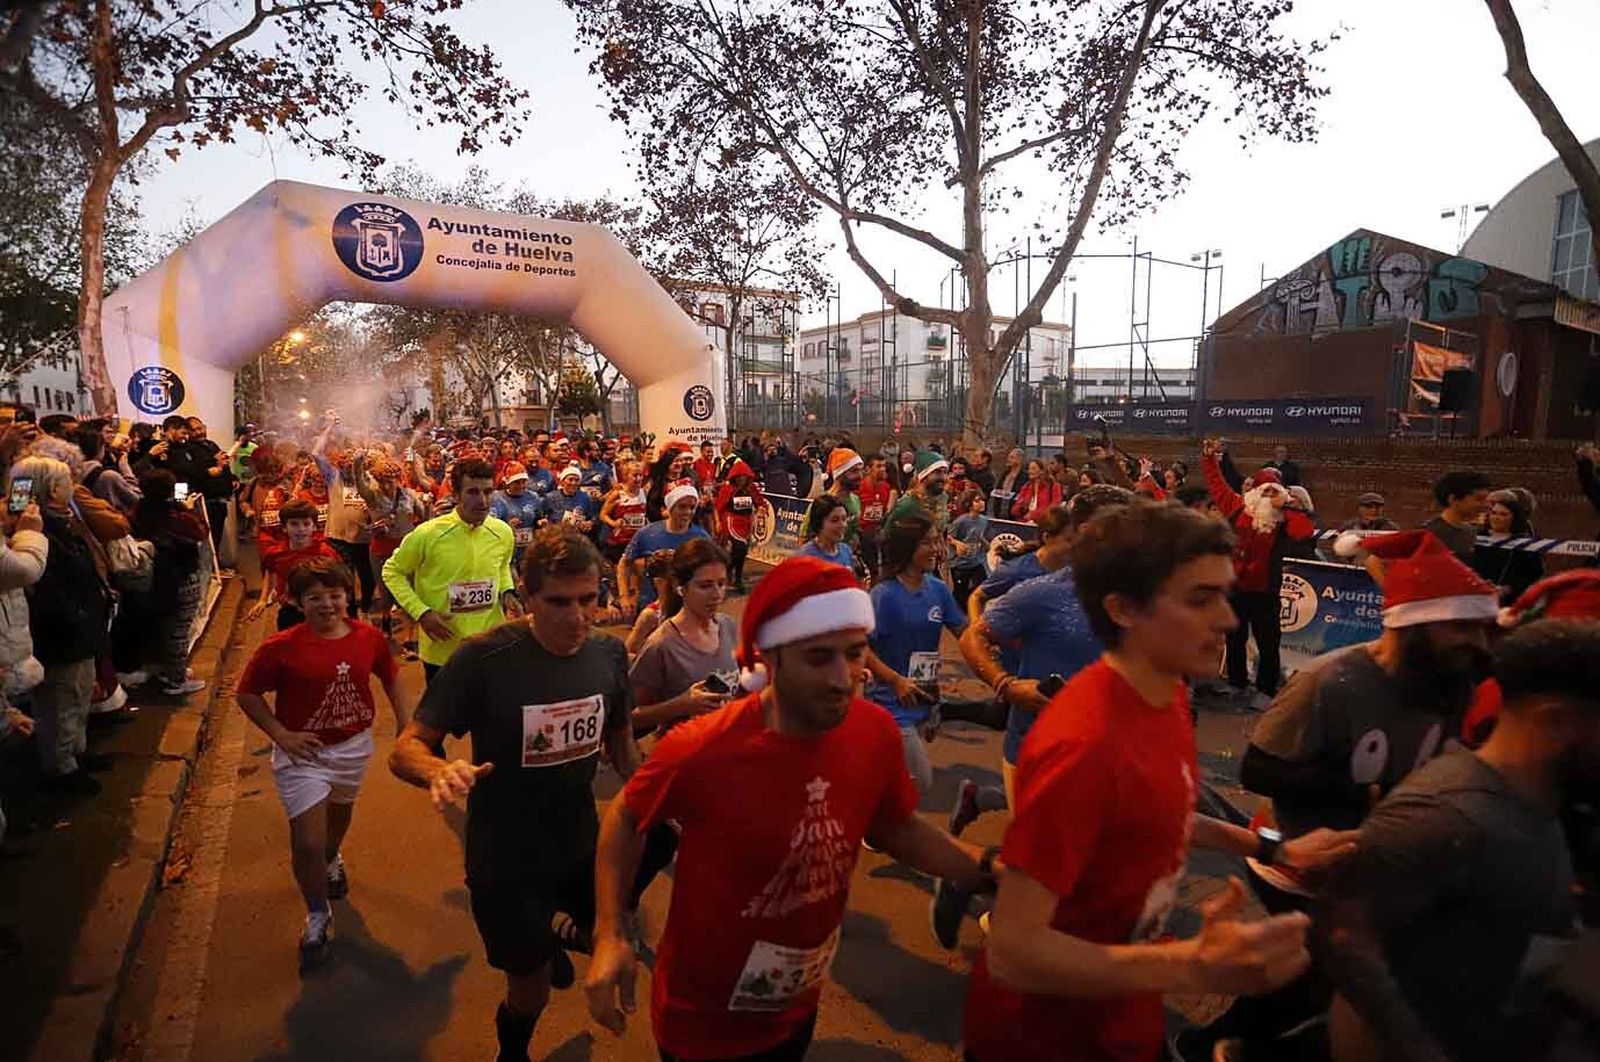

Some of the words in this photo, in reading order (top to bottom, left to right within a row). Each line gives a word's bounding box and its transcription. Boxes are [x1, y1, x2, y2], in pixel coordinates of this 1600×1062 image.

[427, 217, 573, 246] Ayuntamiento
[472, 239, 498, 255] de
[505, 242, 574, 263] Huelva
[505, 262, 520, 272] de
[524, 263, 576, 277] Deportes
[1149, 409, 1188, 417] HYUNDAI
[1227, 408, 1274, 416] HYUNDAI
[1308, 406, 1362, 416] HYUNDAI
[687, 434, 698, 442] de
[786, 522, 798, 533] de
[469, 589, 492, 604] 236
[1322, 586, 1384, 606] Ayunta
[1355, 604, 1379, 618] de
[561, 716, 597, 744] 168
